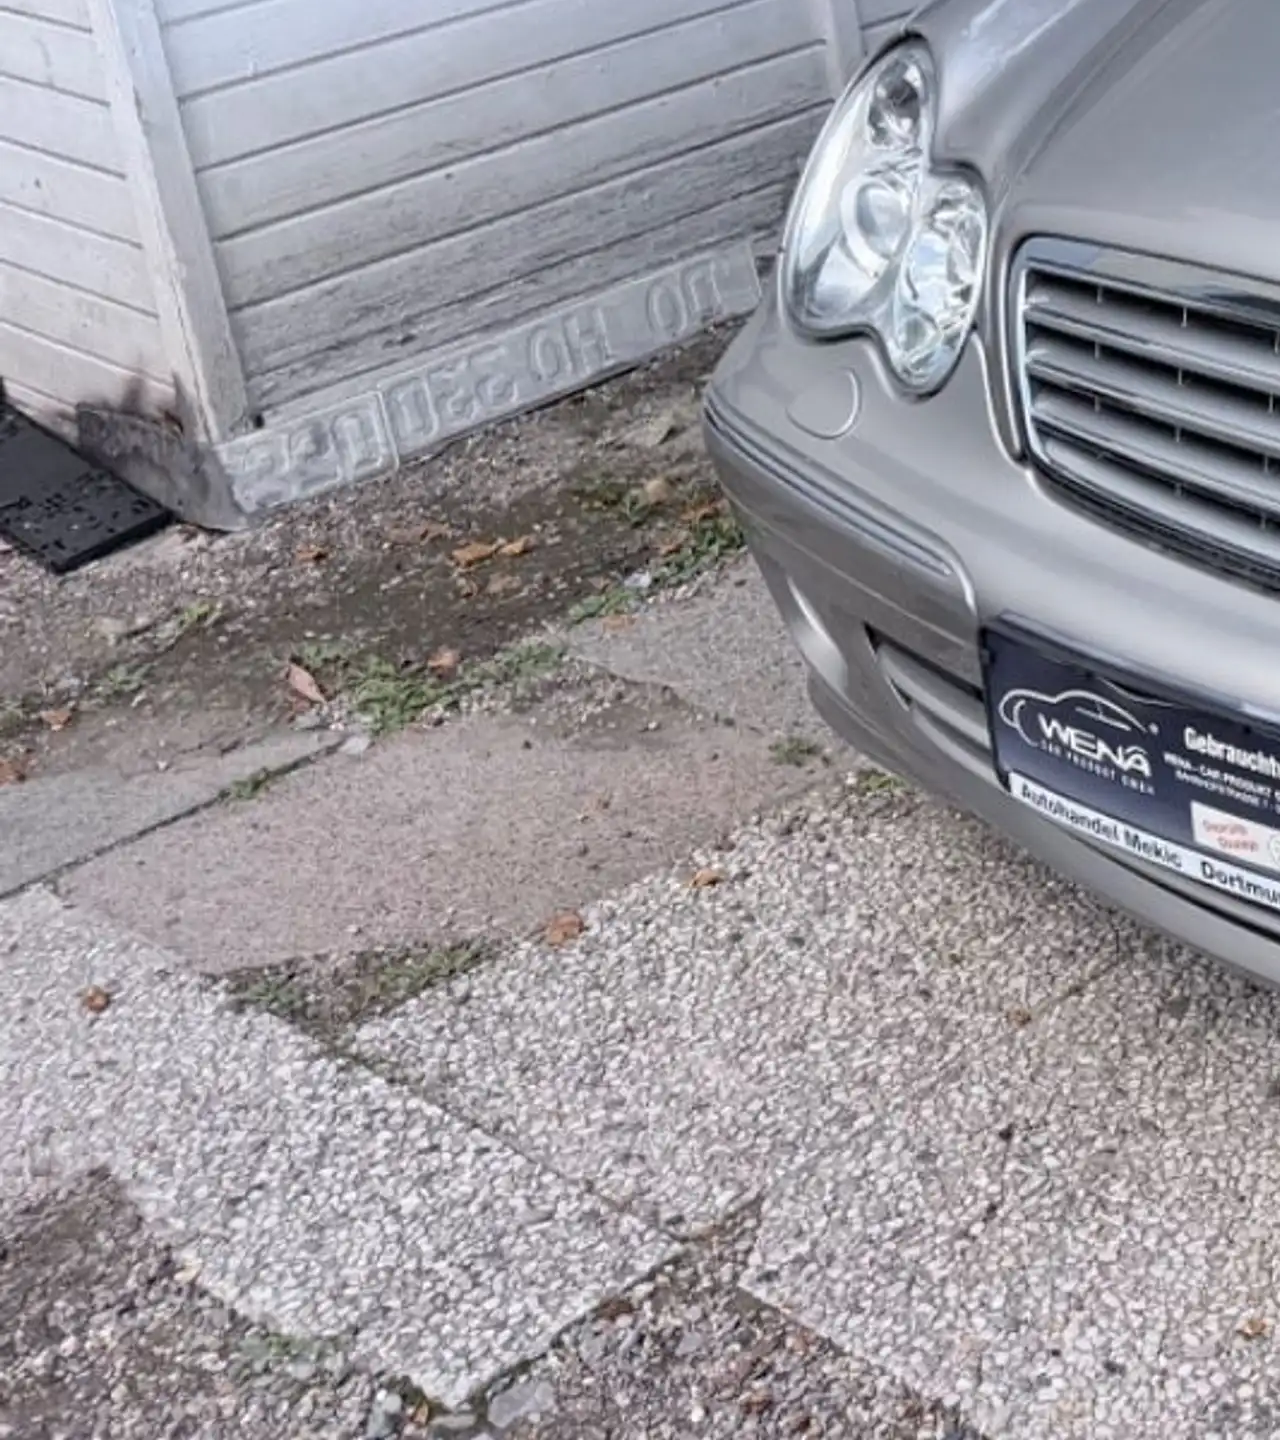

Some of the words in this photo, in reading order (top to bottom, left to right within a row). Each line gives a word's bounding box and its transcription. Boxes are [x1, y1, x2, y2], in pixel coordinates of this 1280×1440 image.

[1037, 712, 1152, 778] WENA
[1021, 781, 1120, 841] Autohandel
[1124, 829, 1183, 869] Mekic
